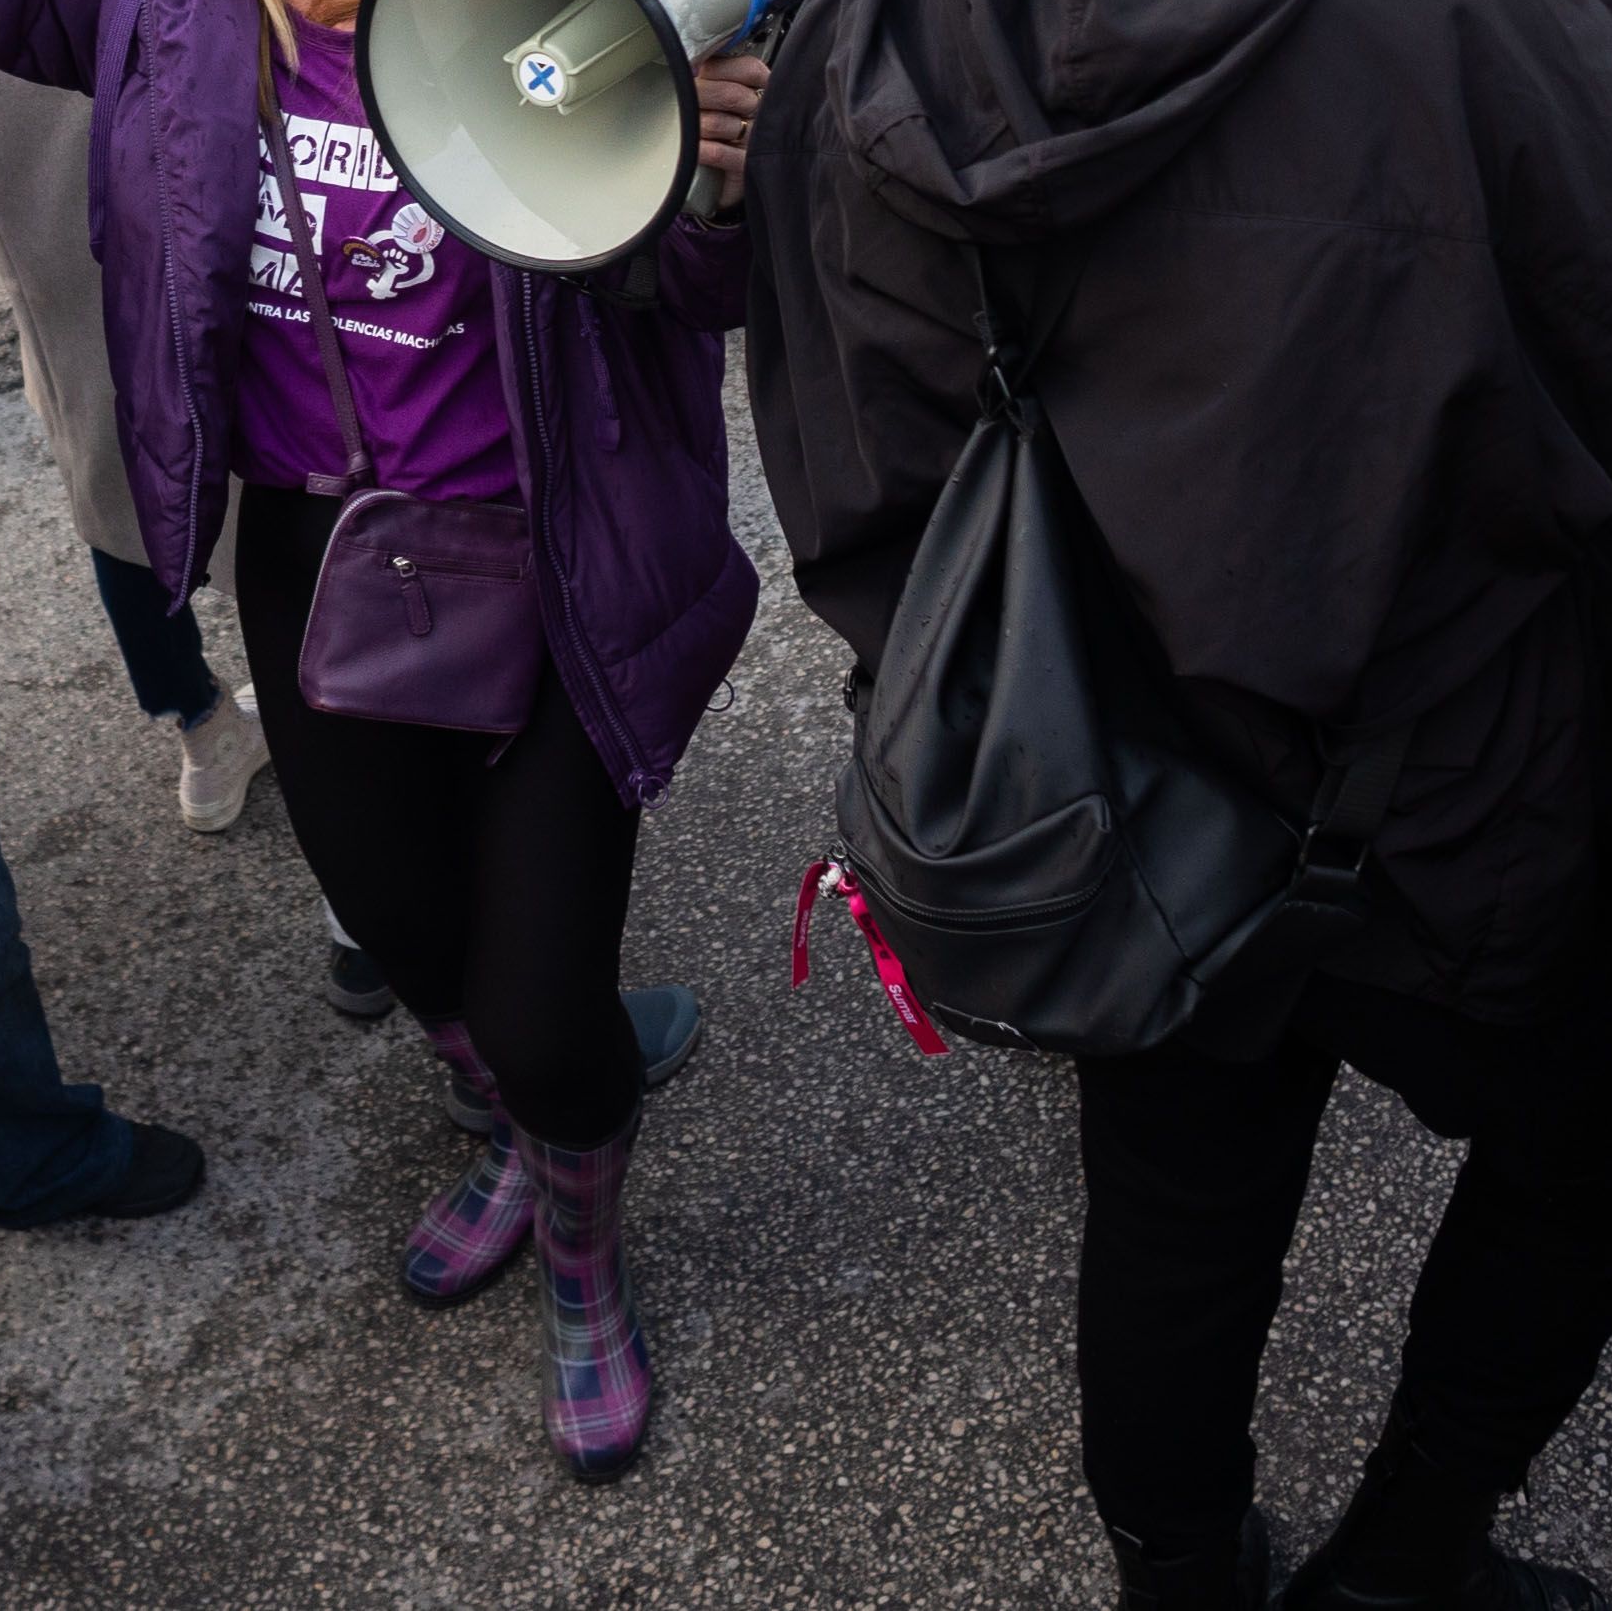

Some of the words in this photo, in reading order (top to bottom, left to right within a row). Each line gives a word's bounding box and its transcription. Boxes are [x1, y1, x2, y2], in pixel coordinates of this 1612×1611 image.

[284, 307, 311, 323] LAS
[393, 321, 465, 349] MACHIAS
[888, 983, 918, 1025] Sumar
